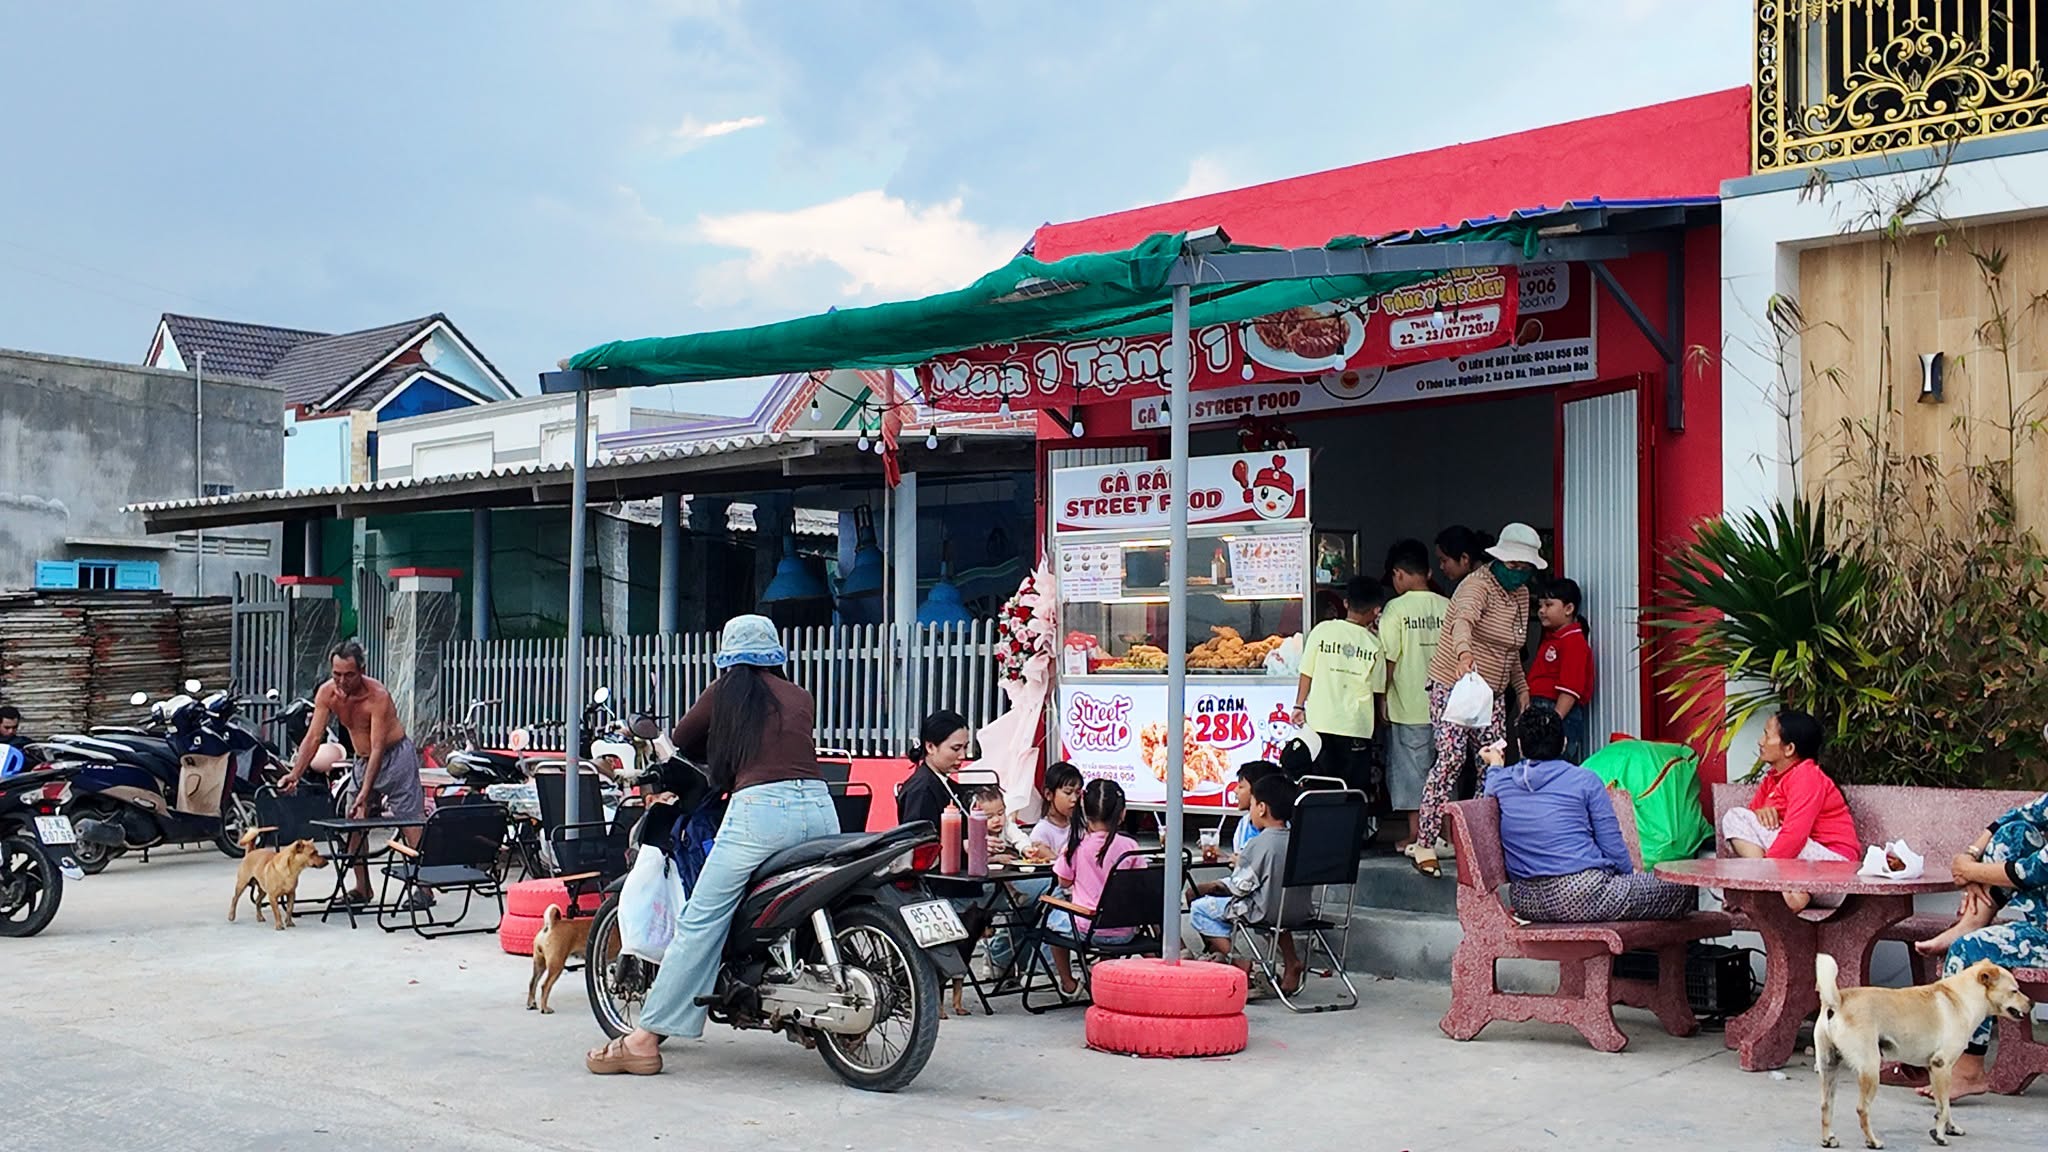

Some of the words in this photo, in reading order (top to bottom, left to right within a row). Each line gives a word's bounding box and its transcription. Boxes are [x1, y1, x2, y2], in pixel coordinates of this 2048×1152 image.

[1400, 333, 1415, 345] 22
[931, 361, 1029, 397] Mua
[1036, 350, 1060, 391] 1
[1201, 326, 1230, 369] 1
[1138, 404, 1157, 424] GÀ
[1195, 396, 1254, 417] STREET
[1258, 390, 1301, 411] FOOD
[1100, 470, 1130, 494] GÀ
[1137, 467, 1172, 490] RÁ
[1065, 495, 1153, 517] STREET
[1158, 490, 1223, 512] FOD
[1072, 696, 1129, 726] Street
[1197, 695, 1214, 712] GÀ
[1217, 694, 1244, 712] RÁN
[1073, 723, 1117, 747] Food
[1195, 712, 1249, 743] 28K
